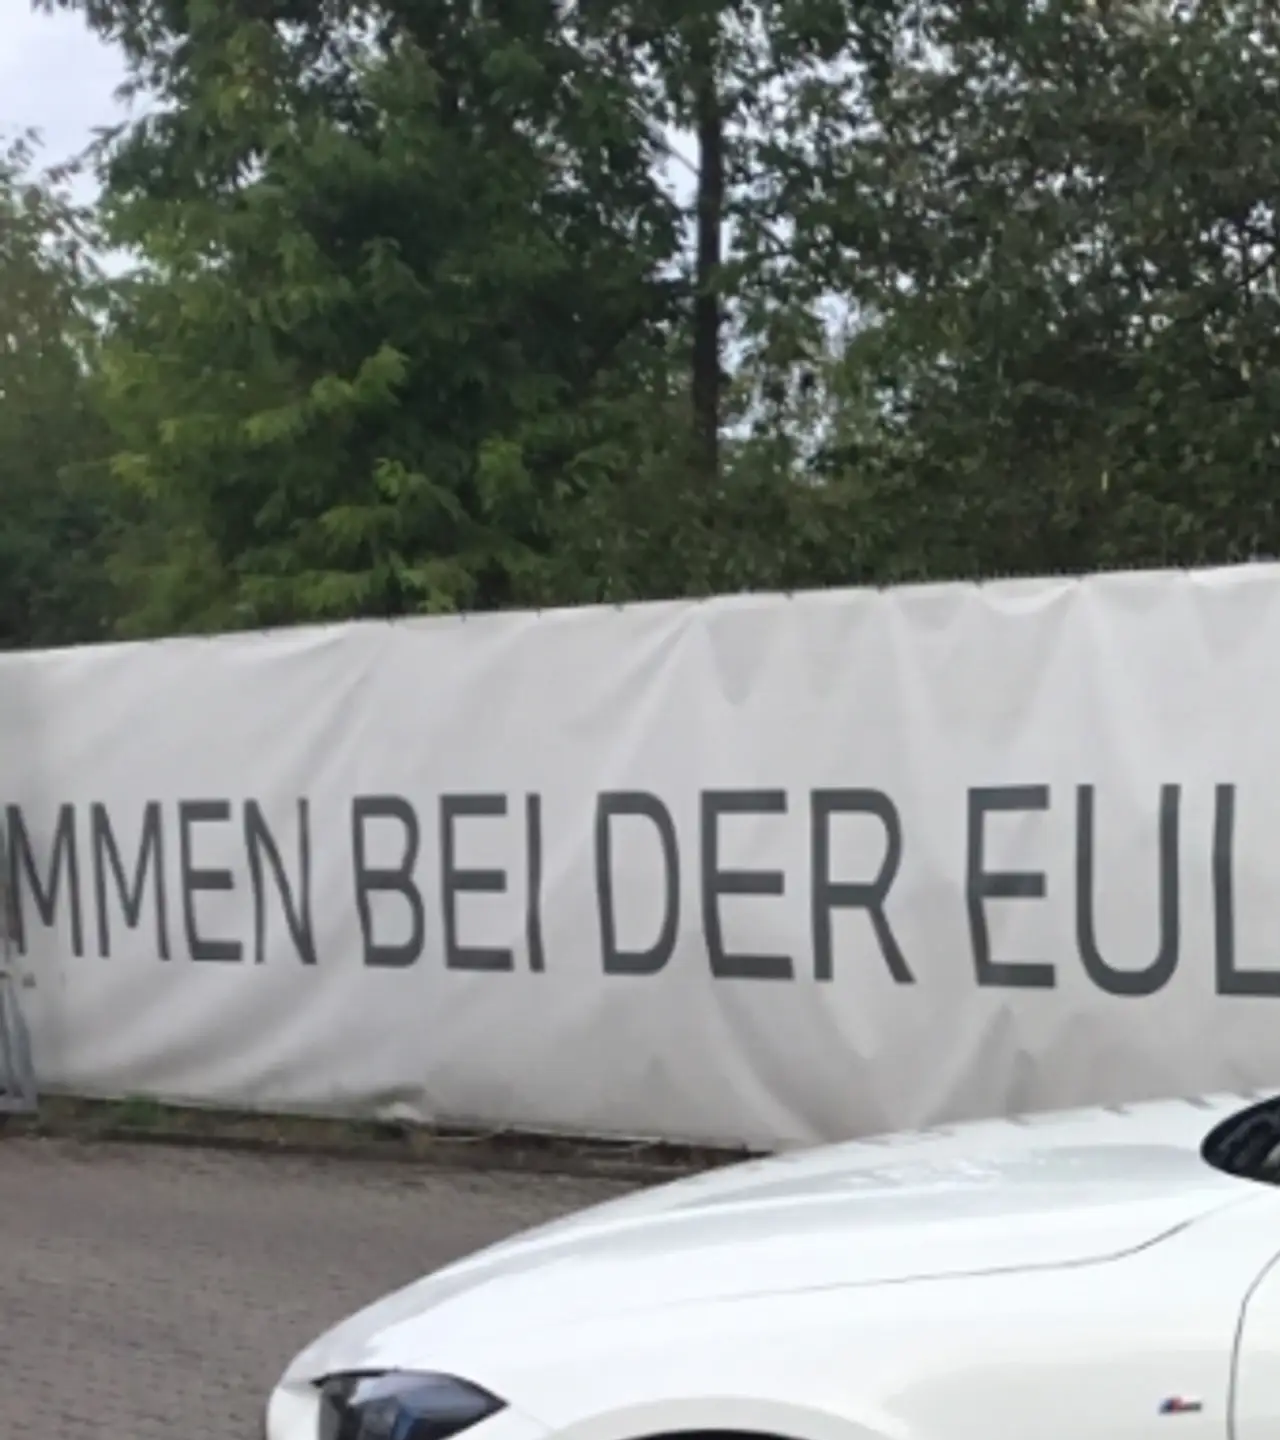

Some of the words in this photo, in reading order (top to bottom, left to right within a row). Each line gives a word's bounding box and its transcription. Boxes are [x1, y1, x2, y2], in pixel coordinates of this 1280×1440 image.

[6, 799, 317, 965] MMEN
[351, 793, 546, 973] BEI
[596, 789, 917, 984] DER
